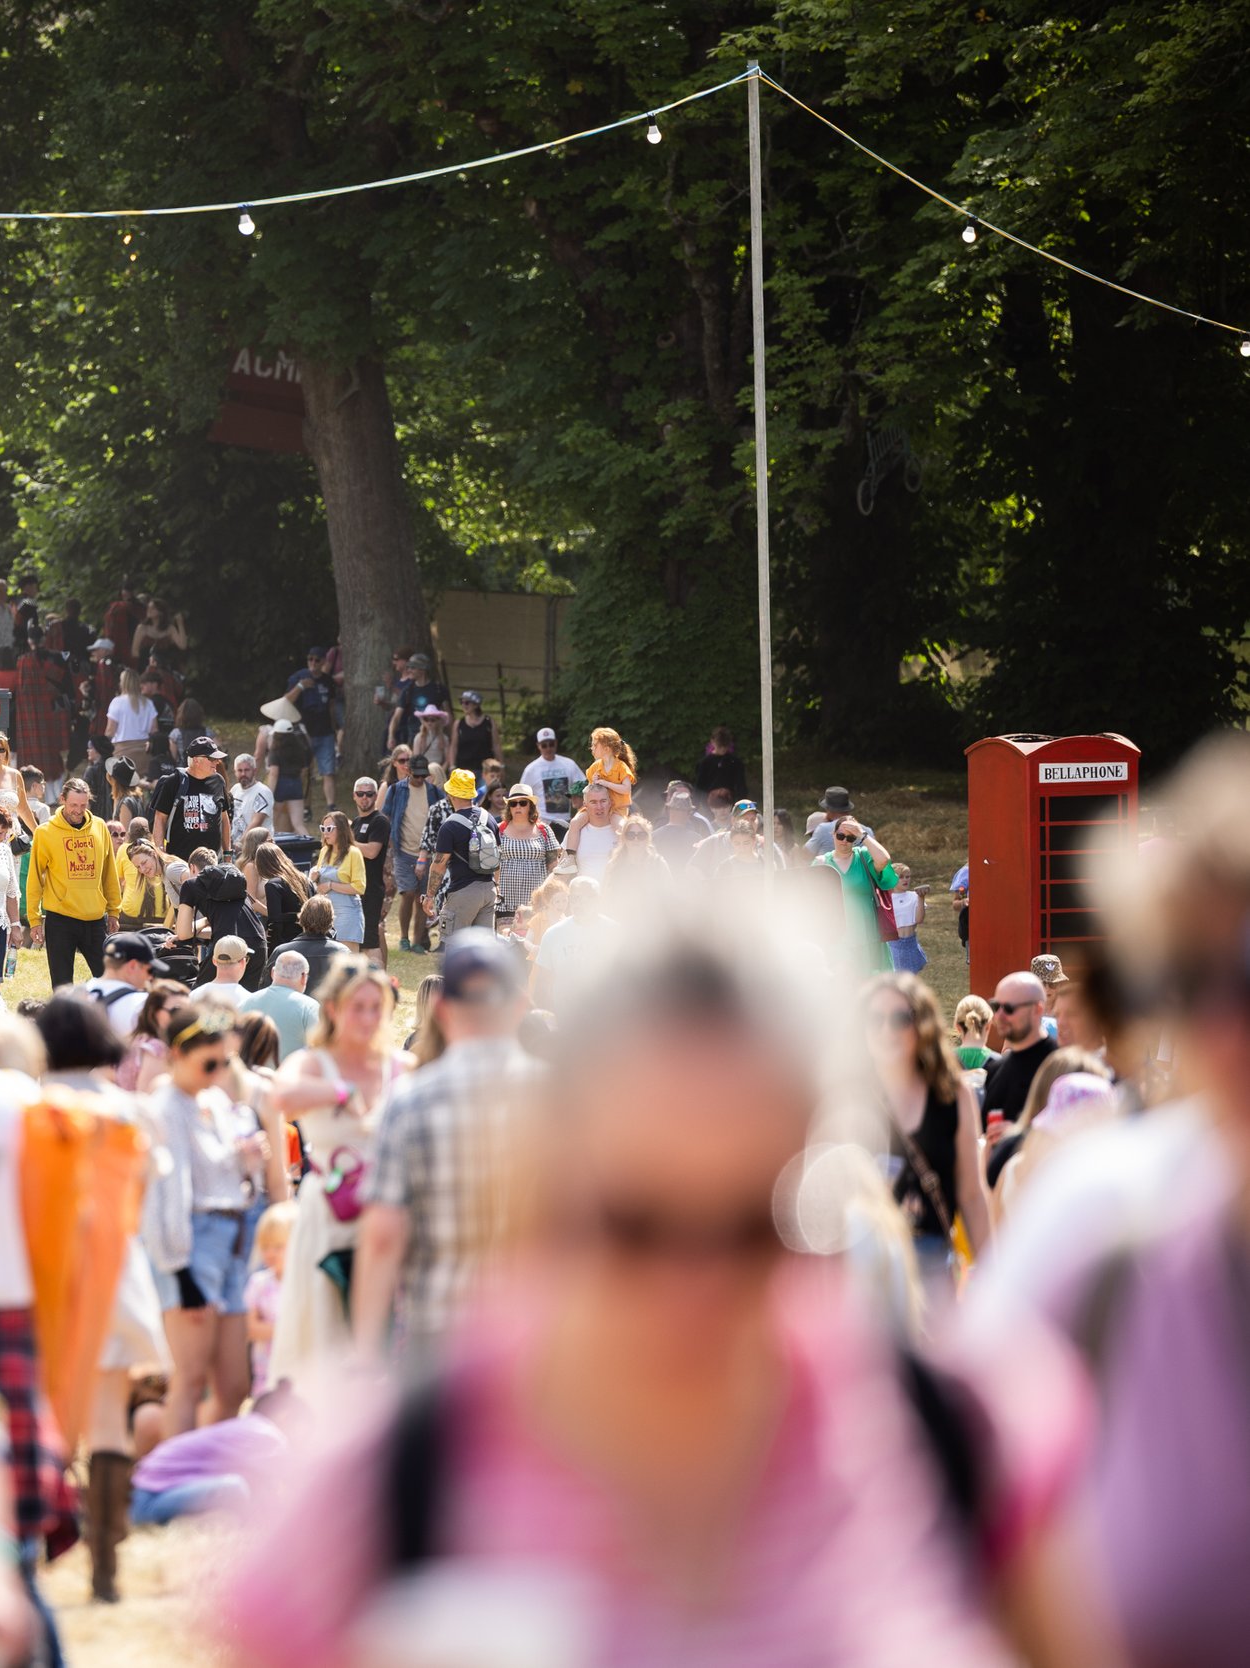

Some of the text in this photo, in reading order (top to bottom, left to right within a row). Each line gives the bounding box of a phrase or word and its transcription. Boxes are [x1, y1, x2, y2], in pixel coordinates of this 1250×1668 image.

[232, 347, 302, 383] ACM
[1044, 765, 1124, 780] BELLAPHONE
[69, 860, 95, 872] Mustard
